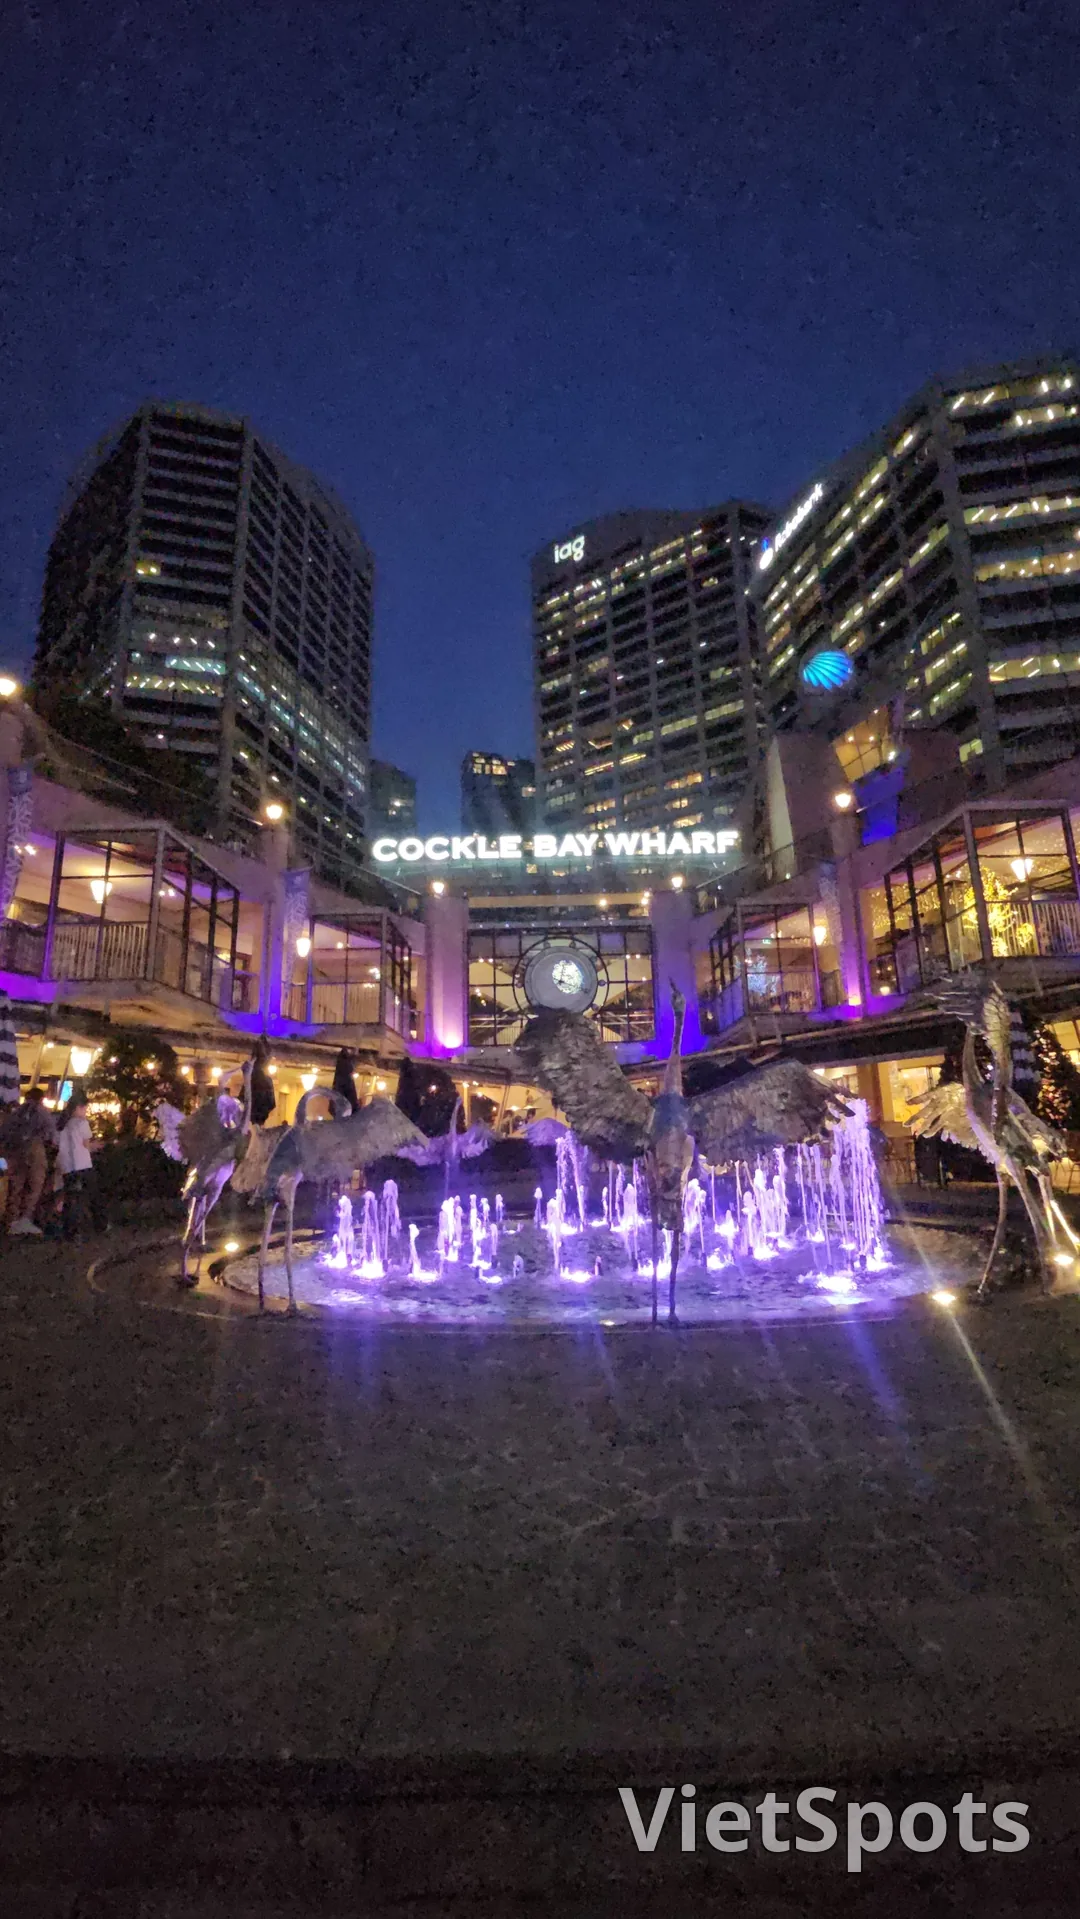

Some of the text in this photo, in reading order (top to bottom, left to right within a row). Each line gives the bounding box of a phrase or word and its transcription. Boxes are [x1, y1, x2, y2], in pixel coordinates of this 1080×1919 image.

[553, 535, 585, 563] iag
[372, 830, 739, 862] COCKLE BAY WHARF
